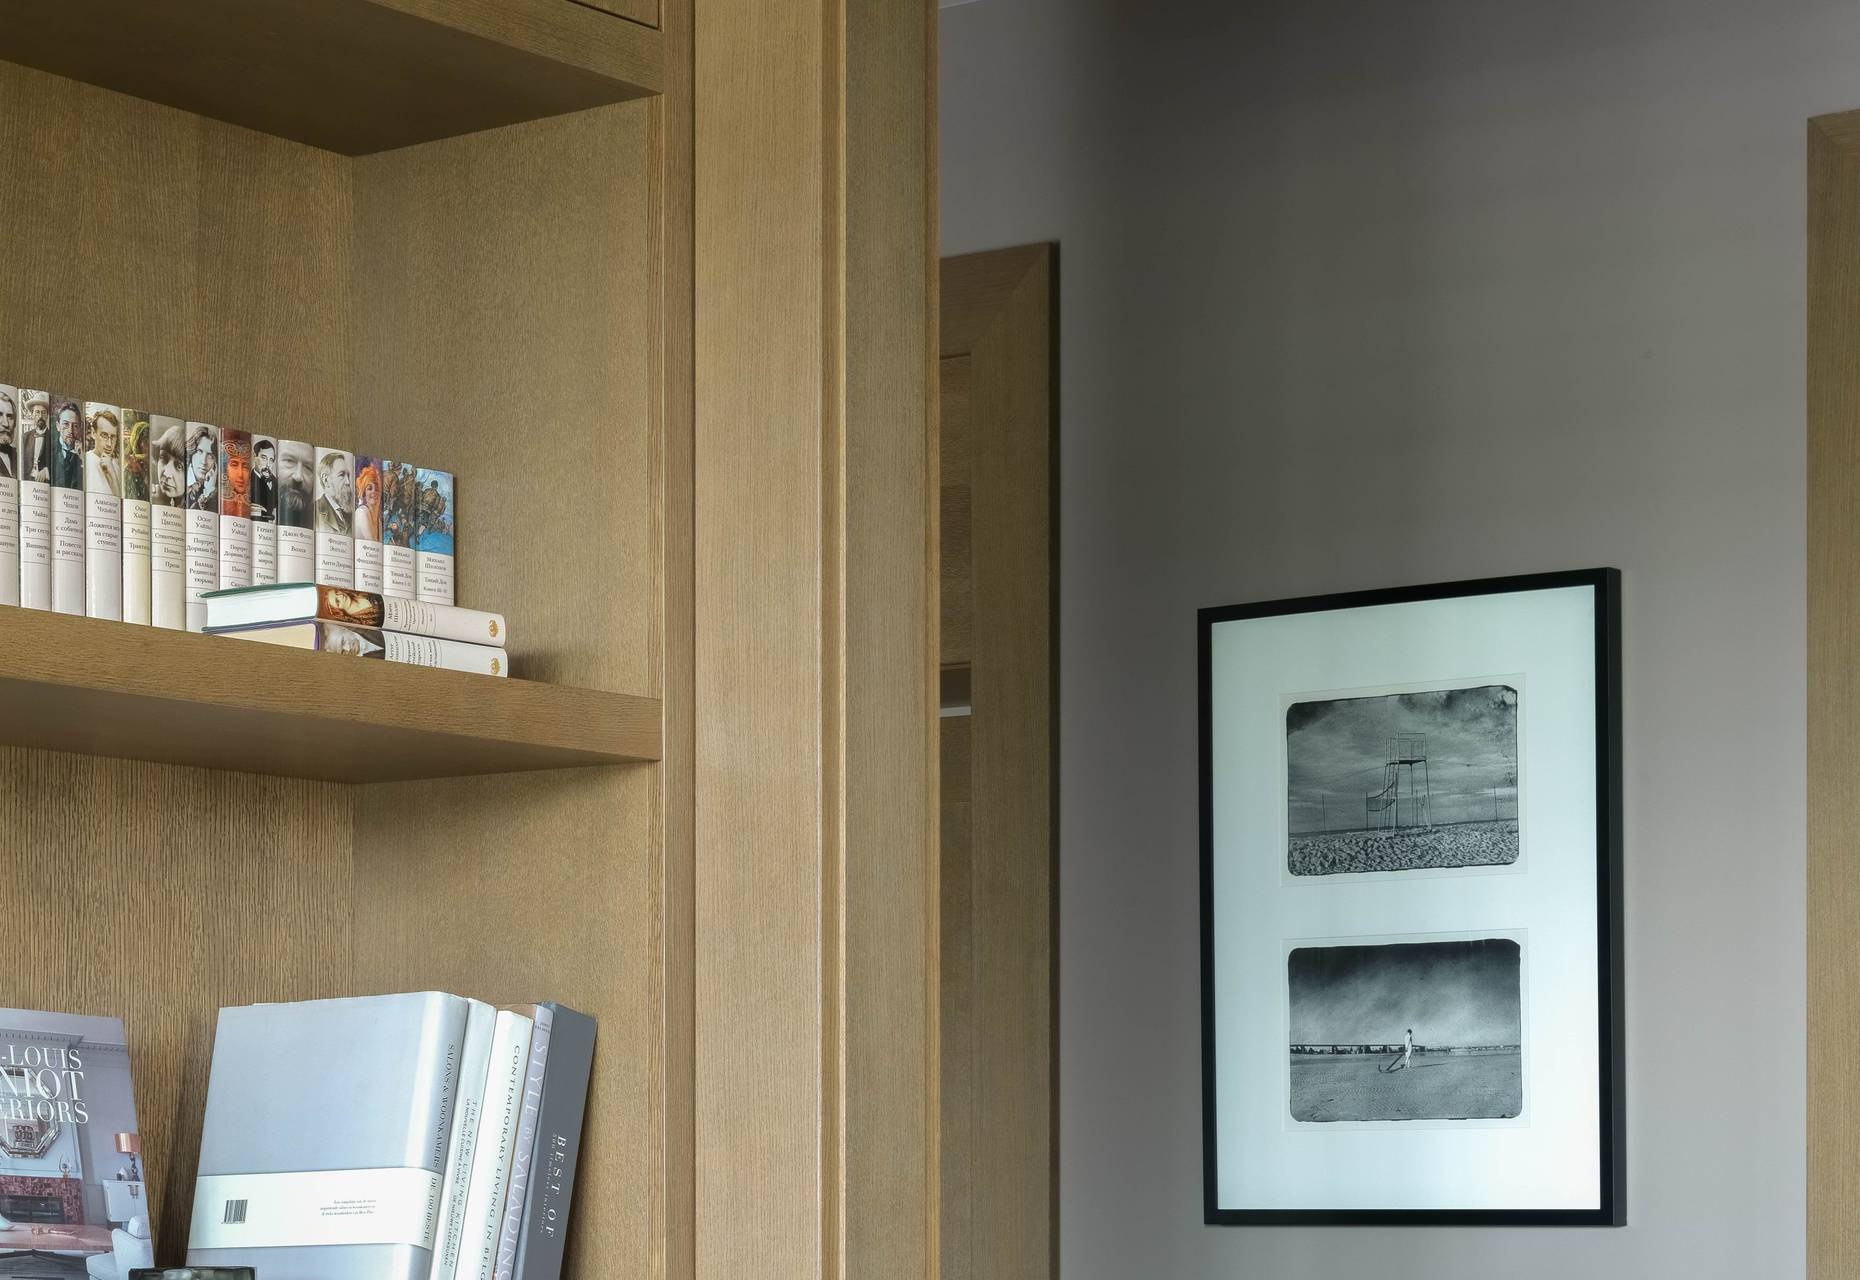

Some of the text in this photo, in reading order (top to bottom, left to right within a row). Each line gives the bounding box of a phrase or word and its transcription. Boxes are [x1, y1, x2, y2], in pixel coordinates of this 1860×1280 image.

[444, 1044, 455, 1082] SALONS
[526, 1042, 546, 1115] STYLE
[0, 1098, 88, 1124] RIORS
[498, 1045, 520, 1162] CONTEMPORARY
[434, 1097, 448, 1168] WOONKAMERS
[458, 1163, 468, 1206] LIVING
[490, 1168, 502, 1218] LIVING
[546, 1136, 566, 1238] BEST OF
[424, 1212, 432, 1242] BESTE
[449, 1213, 460, 1268] KITCHEN
[486, 1225, 492, 1240] IN
